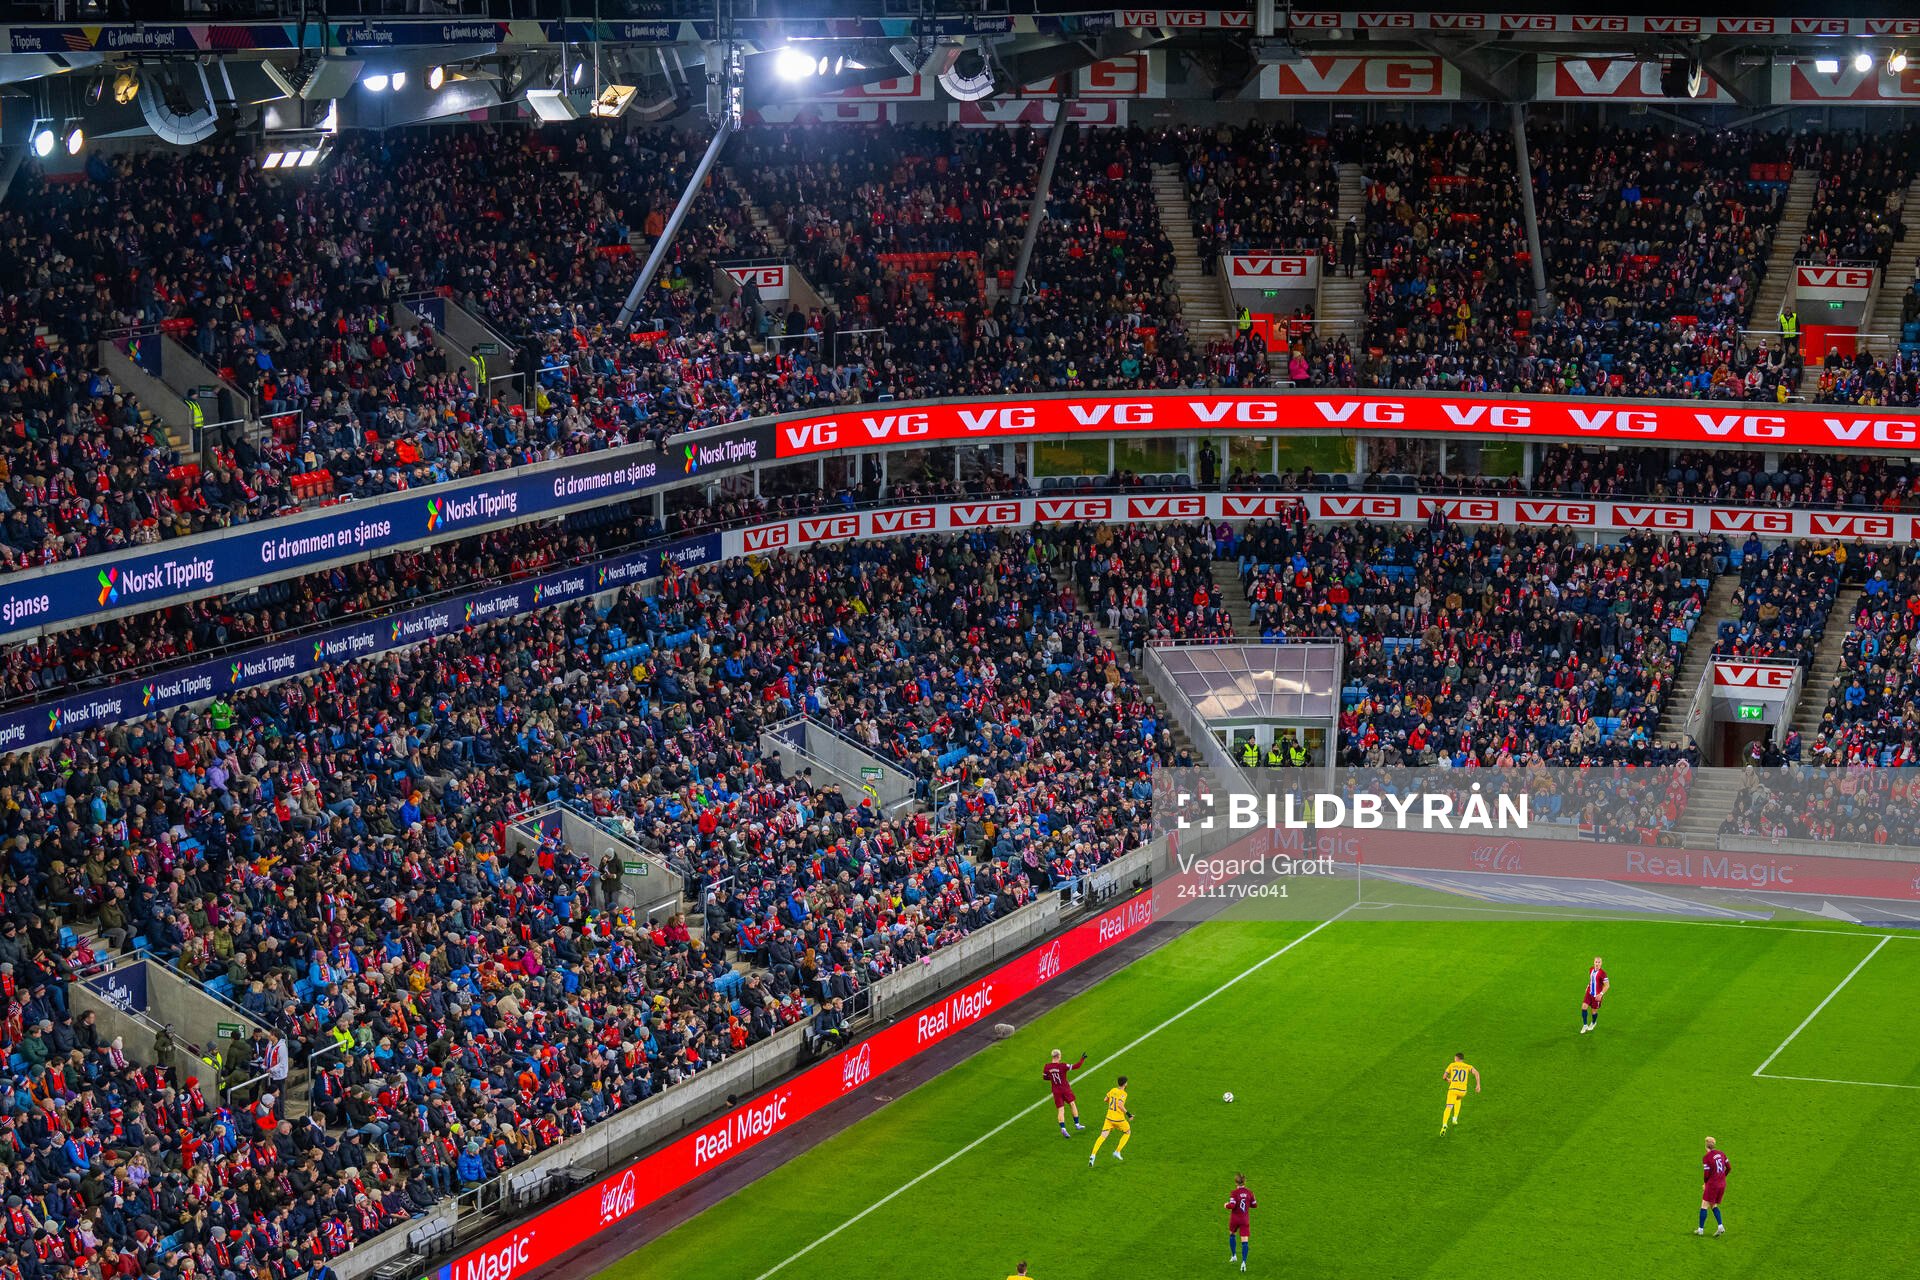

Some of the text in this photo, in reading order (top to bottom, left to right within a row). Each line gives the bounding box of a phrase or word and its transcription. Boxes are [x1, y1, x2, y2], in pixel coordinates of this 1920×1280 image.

[1124, 12, 1155, 25] VG
[1167, 12, 1203, 25] VG
[1290, 13, 1337, 27] VG
[1358, 14, 1411, 27] VG
[1430, 15, 1483, 28] VG
[1501, 16, 1553, 30] VG
[1573, 17, 1625, 30] VG
[1647, 18, 1698, 31] VG
[1719, 19, 1772, 32] VG
[1793, 20, 1847, 33] VG
[1867, 20, 1920, 33] VG
[1287, 59, 1434, 93] VG
[1797, 63, 1920, 97] VG
[729, 269, 780, 286] VG
[1237, 259, 1302, 275] VG
[1801, 269, 1868, 287] VG
[957, 407, 1035, 431] VG
[1068, 404, 1153, 425] VG
[1188, 402, 1277, 422] VG
[1314, 402, 1404, 423] VG
[1441, 405, 1531, 427] VG
[1568, 409, 1657, 433] VG
[786, 422, 838, 449] VG
[862, 413, 929, 438] VG
[1694, 414, 1786, 438] VG
[1823, 419, 1916, 442] VG
[699, 439, 757, 466] Norsk Tipping
[553, 461, 656, 497] Gi drømmen en sjanse
[446, 489, 517, 522] Norsk Tipping
[953, 505, 1017, 524] VG
[1038, 500, 1106, 519] VG
[1132, 499, 1200, 516] VG
[1324, 498, 1396, 515] VG
[1519, 503, 1590, 523] VG
[875, 509, 931, 531] VG
[1616, 506, 1690, 527] VG
[1714, 511, 1787, 531] VG
[1814, 515, 1888, 536] VG
[746, 527, 786, 548] VG
[801, 518, 856, 539] VG
[262, 520, 391, 562] Gi drømmen en sjanse
[122, 556, 214, 595] Norsk Tipping
[608, 561, 647, 580] Norsk Tipping
[544, 578, 584, 598] Norsk Tipping
[3, 594, 49, 625] sjanse
[476, 594, 519, 615] Norsk Tipping
[403, 613, 449, 635] Norsk Tipping
[326, 632, 375, 655] Norsk Tipping
[244, 653, 295, 677] Norsk Tipping
[157, 675, 212, 699] Norsk Tipping
[1716, 666, 1793, 688] VG
[63, 698, 122, 725] Norsk Tipping
[1274, 828, 1359, 856] Mgic
[1626, 851, 1794, 887] Real Magic
[1099, 892, 1160, 943] Real Magic
[918, 982, 993, 1043] Real Magic
[1452, 1069, 1466, 1082] 20
[695, 1094, 787, 1166] Real Magic
[467, 1234, 530, 1280] Magic
